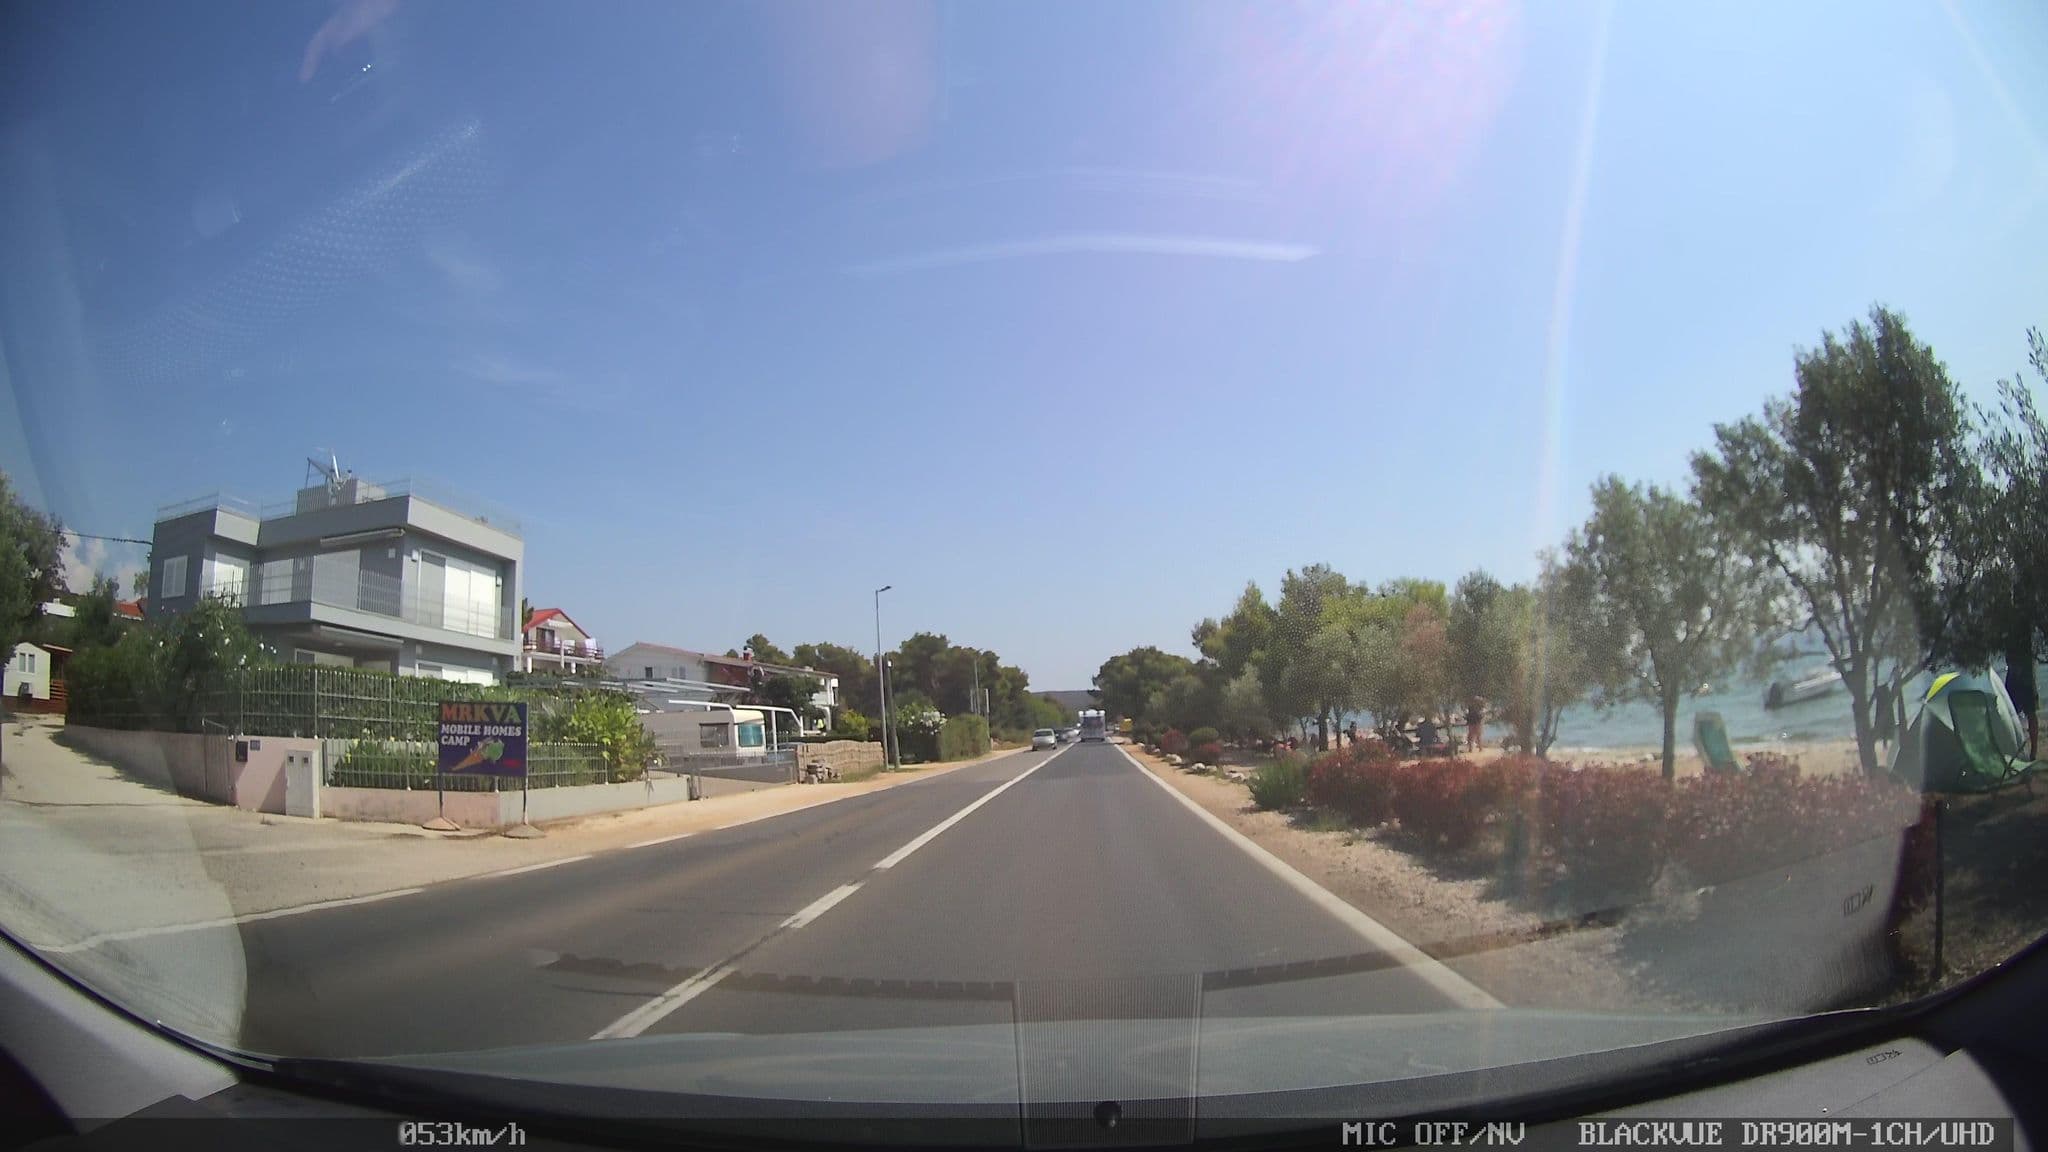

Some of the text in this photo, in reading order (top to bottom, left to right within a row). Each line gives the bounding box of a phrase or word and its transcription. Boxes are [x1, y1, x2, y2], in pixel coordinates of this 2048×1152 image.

[442, 703, 522, 724] MRKVA
[441, 724, 522, 737] MOBILE HOMES
[441, 735, 471, 746] CAMP
